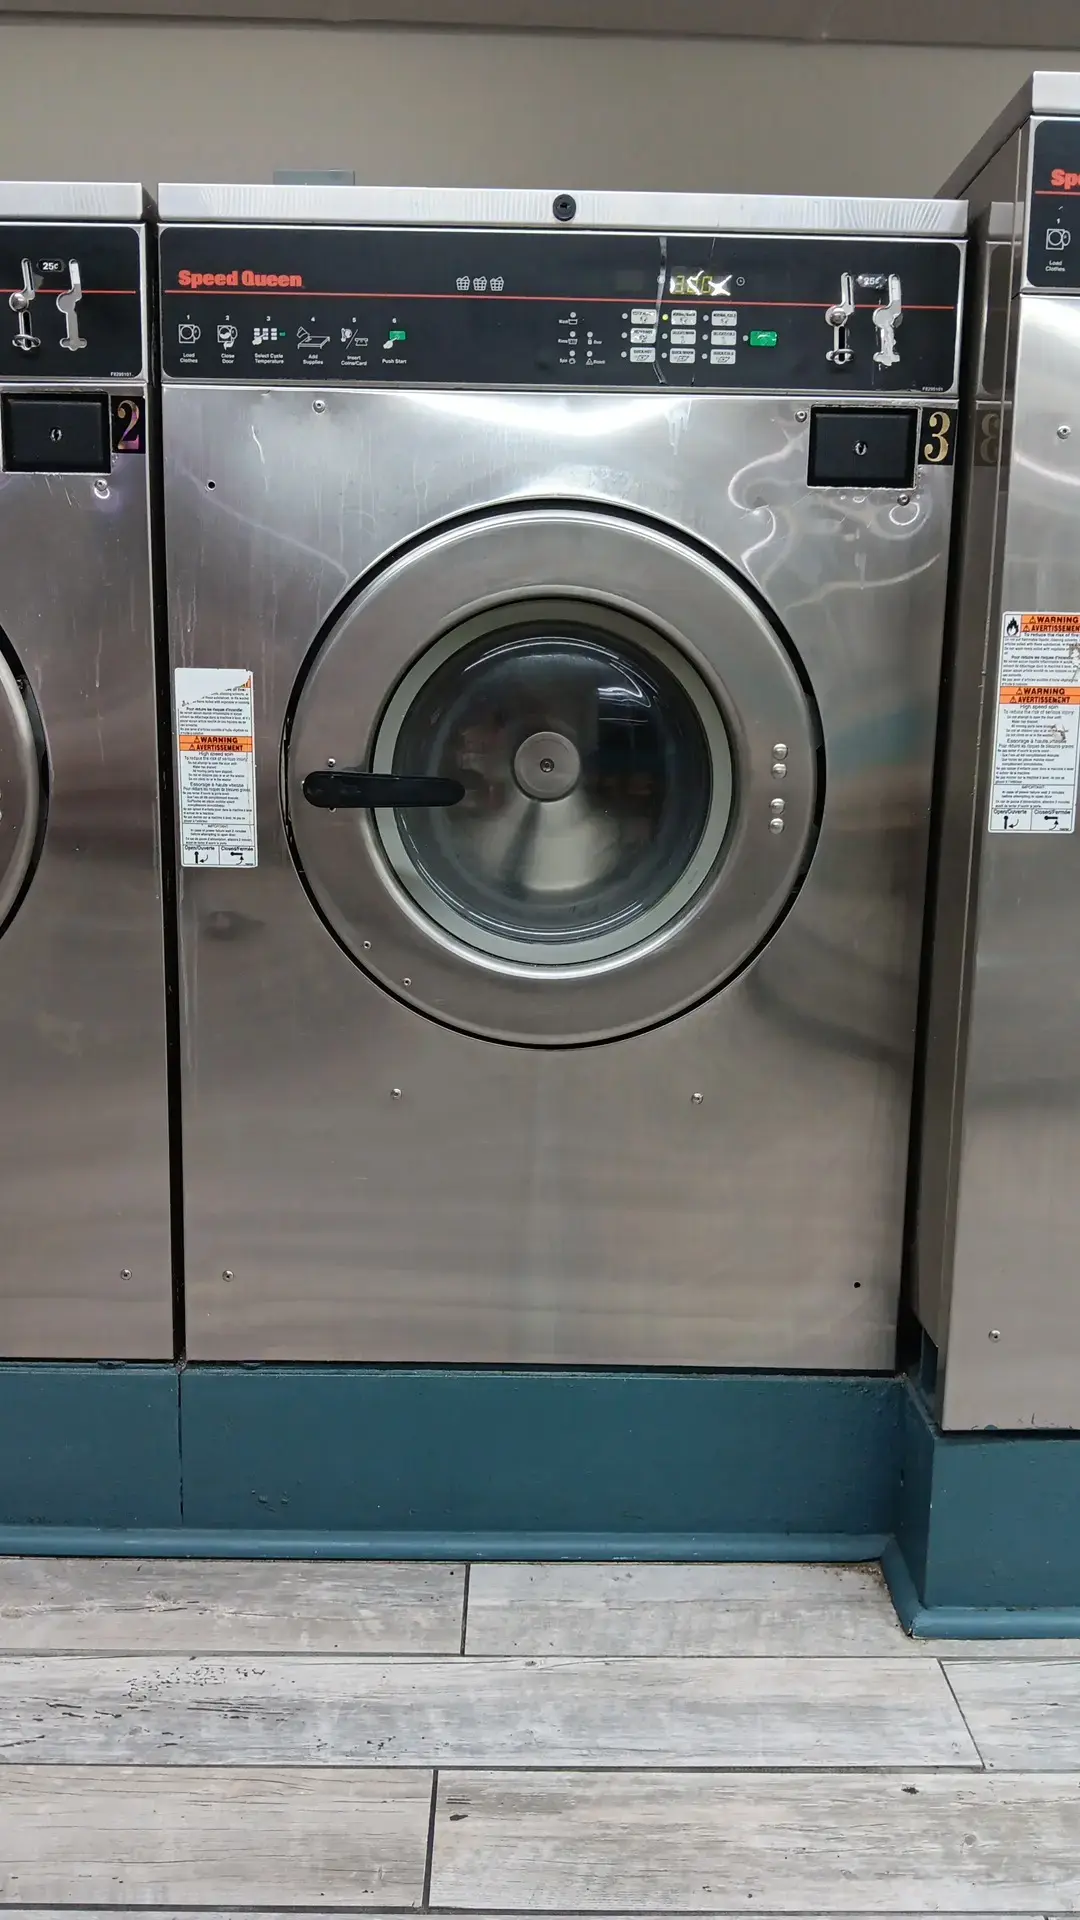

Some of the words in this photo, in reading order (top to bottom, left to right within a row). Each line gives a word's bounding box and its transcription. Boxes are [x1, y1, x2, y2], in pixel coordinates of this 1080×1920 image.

[1051, 169, 1080, 190] Sp
[42, 262, 59, 270] 25¢
[178, 270, 238, 288] Speed
[241, 270, 302, 288] Queen
[117, 400, 140, 450] 2
[924, 411, 950, 462] 3
